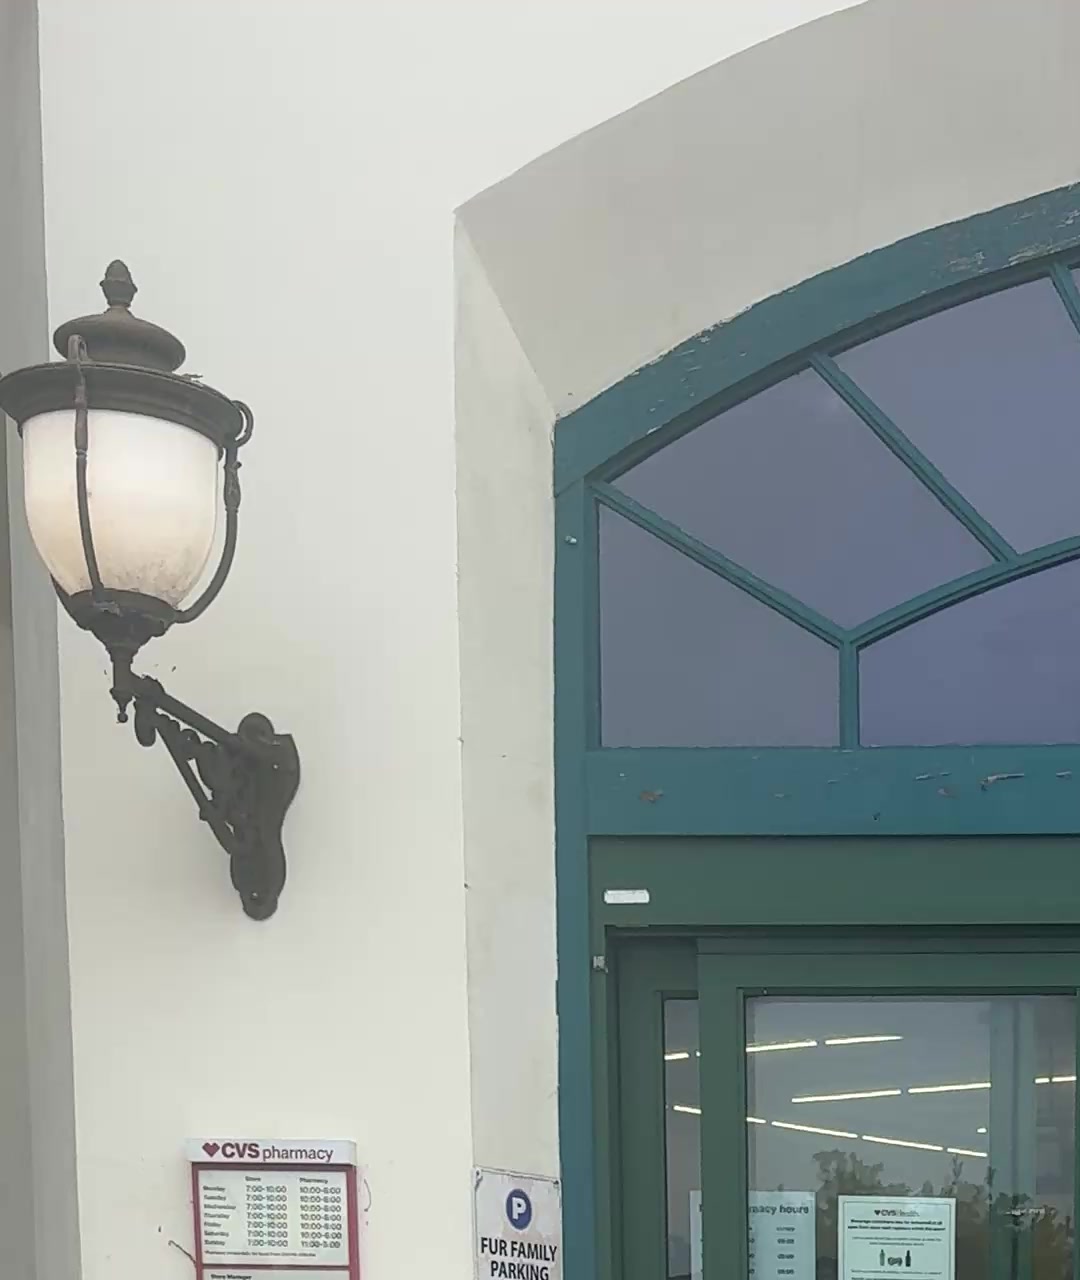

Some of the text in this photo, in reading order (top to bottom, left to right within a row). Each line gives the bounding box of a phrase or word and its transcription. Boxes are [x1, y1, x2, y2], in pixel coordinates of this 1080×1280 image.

[221, 1142, 334, 1162] CVS pharmacy
[512, 1197, 526, 1220] P
[780, 1204, 809, 1214] hours
[481, 1237, 557, 1262] FUR FAMILY
